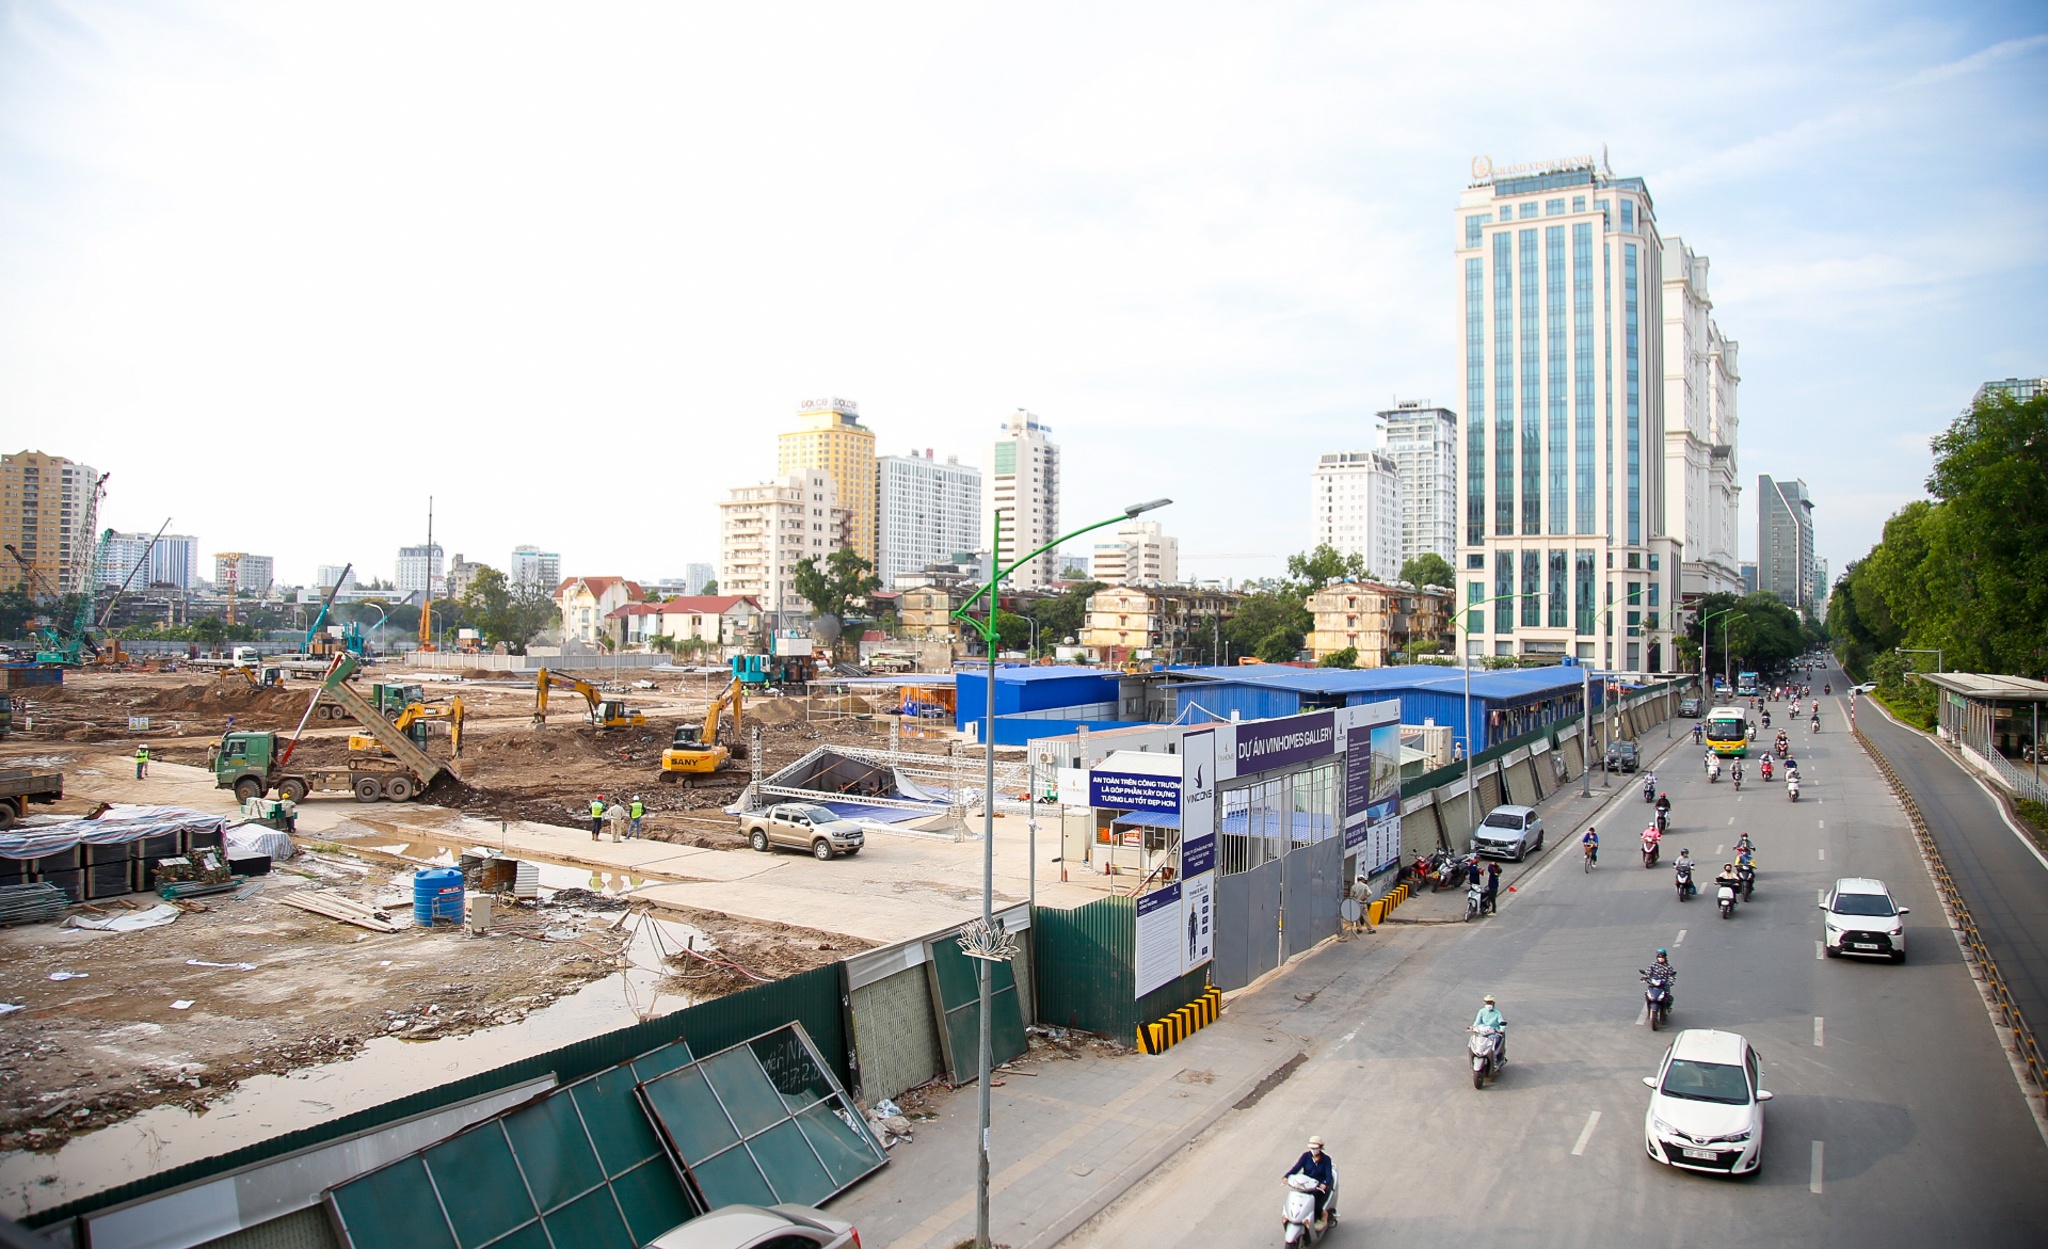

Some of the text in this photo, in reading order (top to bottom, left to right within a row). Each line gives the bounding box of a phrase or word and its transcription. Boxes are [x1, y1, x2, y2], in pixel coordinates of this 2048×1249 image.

[1239, 739, 1252, 761] DỰ
[1252, 736, 1265, 757] ÁN
[1265, 732, 1304, 754] VINHOMES
[1305, 726, 1333, 746] GALLERY
[671, 758, 698, 766] SANY
[1103, 776, 1120, 784] TOÀN
[1120, 777, 1137, 785] TRÊN
[1138, 778, 1156, 787] CÔNG
[1110, 786, 1124, 794] GÓP
[1124, 786, 1141, 795] PHẦN
[1142, 788, 1156, 796] XÂY
[1156, 790, 1176, 798] DỰNG
[1186, 789, 1213, 804] VINCONS
[1101, 795, 1123, 803] TƯƠNG
[1134, 796, 1147, 804] TỐT
[1147, 798, 1161, 806] ĐẸP
[1161, 799, 1176, 807] HƠN
